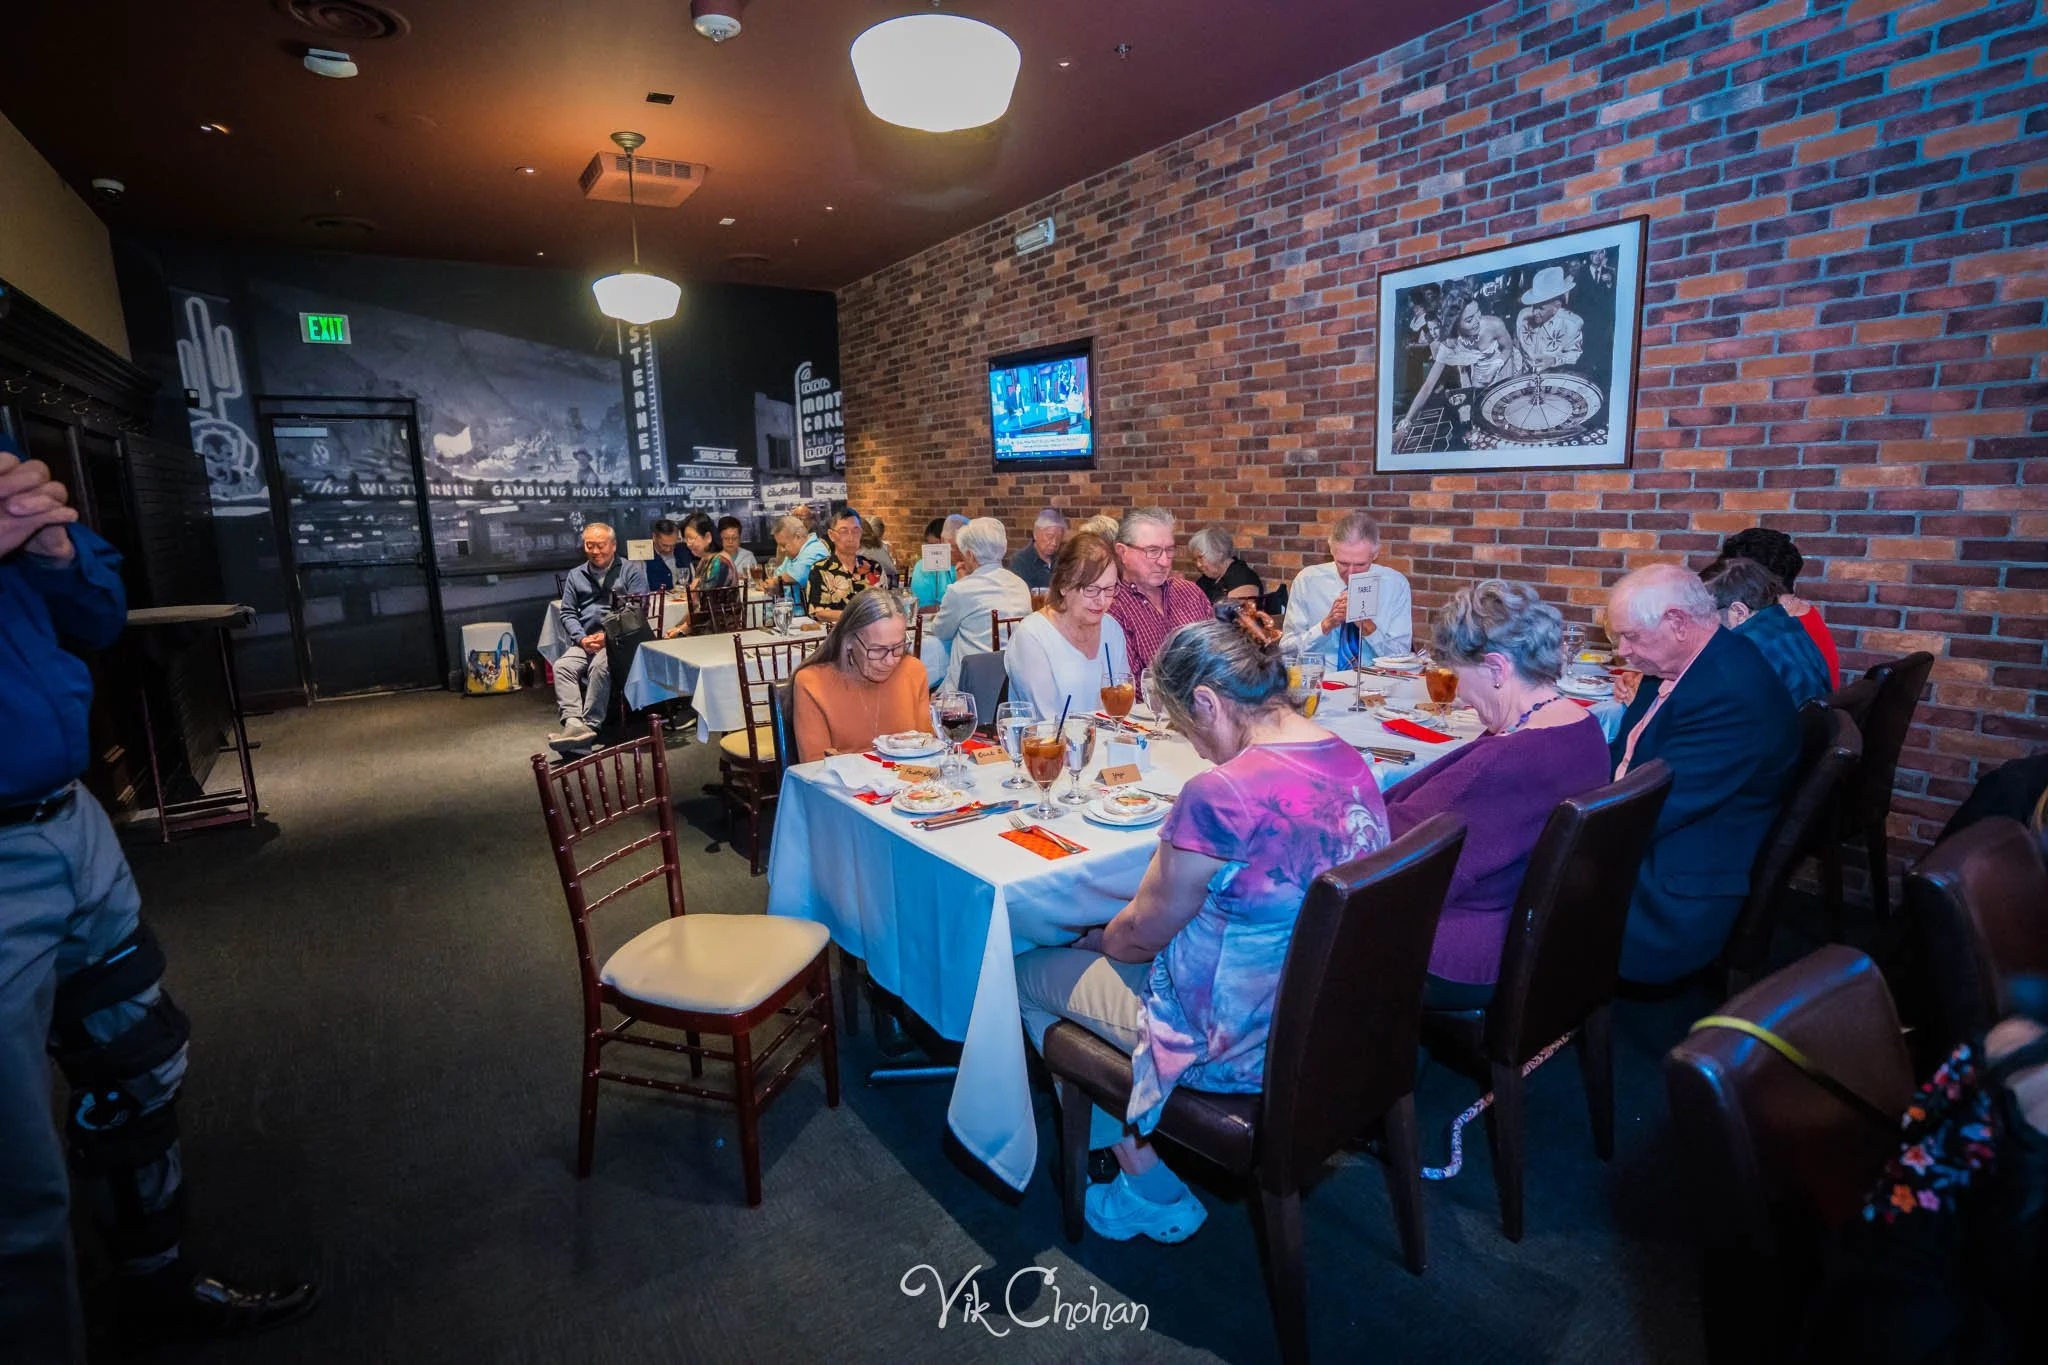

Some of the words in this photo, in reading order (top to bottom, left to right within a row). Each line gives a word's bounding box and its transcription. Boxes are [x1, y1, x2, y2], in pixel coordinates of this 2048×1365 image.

[307, 315, 344, 341] EXIT
[303, 478, 349, 495] The
[491, 485, 566, 497] GAMBLING
[572, 486, 610, 497] HOUSE
[619, 487, 641, 497] SLOT
[1358, 585, 1371, 593] TABLE
